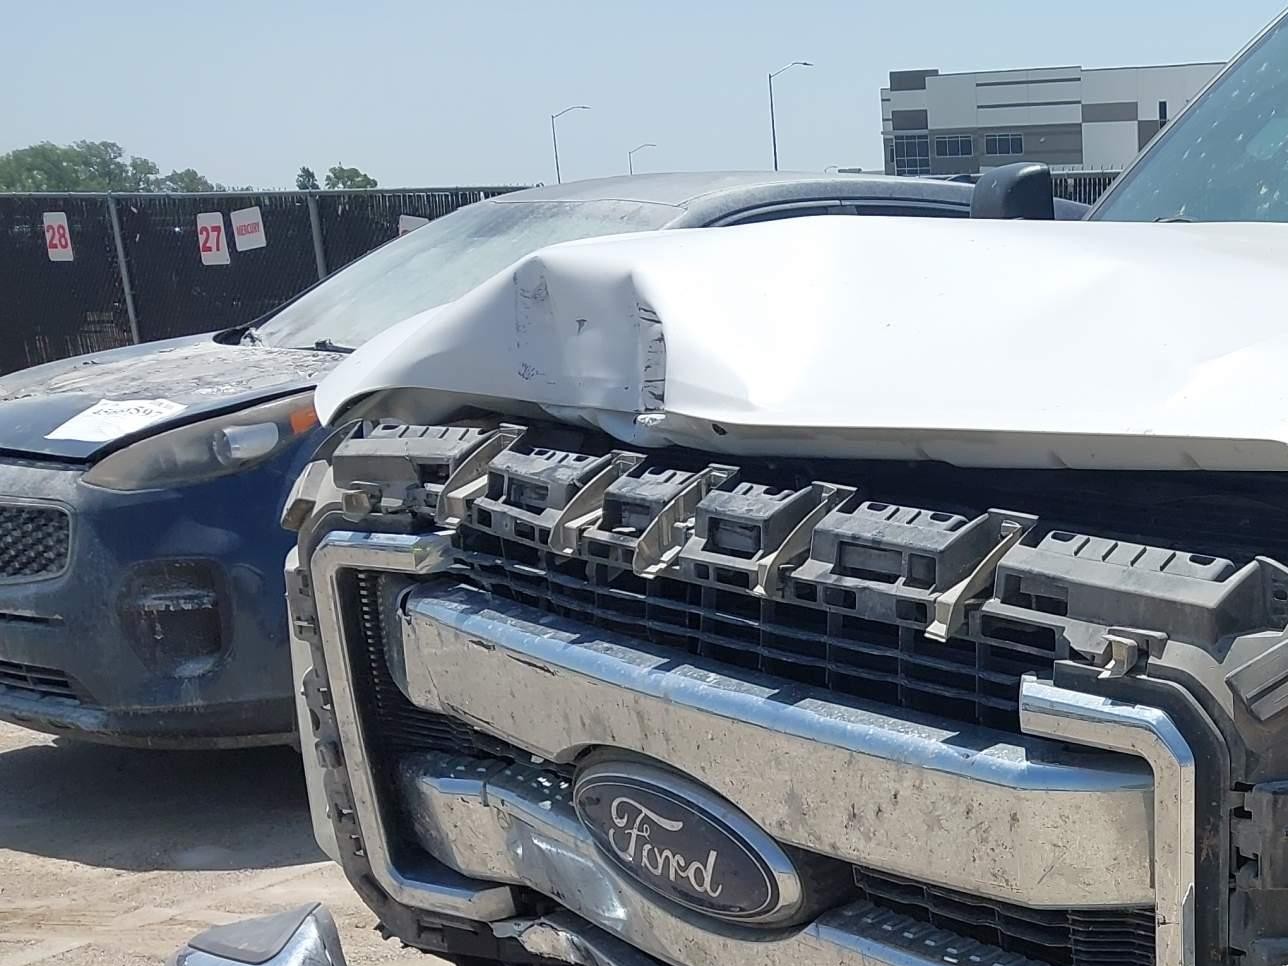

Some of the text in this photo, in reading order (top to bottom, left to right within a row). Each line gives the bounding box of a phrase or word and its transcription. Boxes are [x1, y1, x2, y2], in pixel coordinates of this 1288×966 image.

[46, 224, 69, 250] 28
[199, 225, 223, 253] 27
[608, 796, 723, 898] Ford
